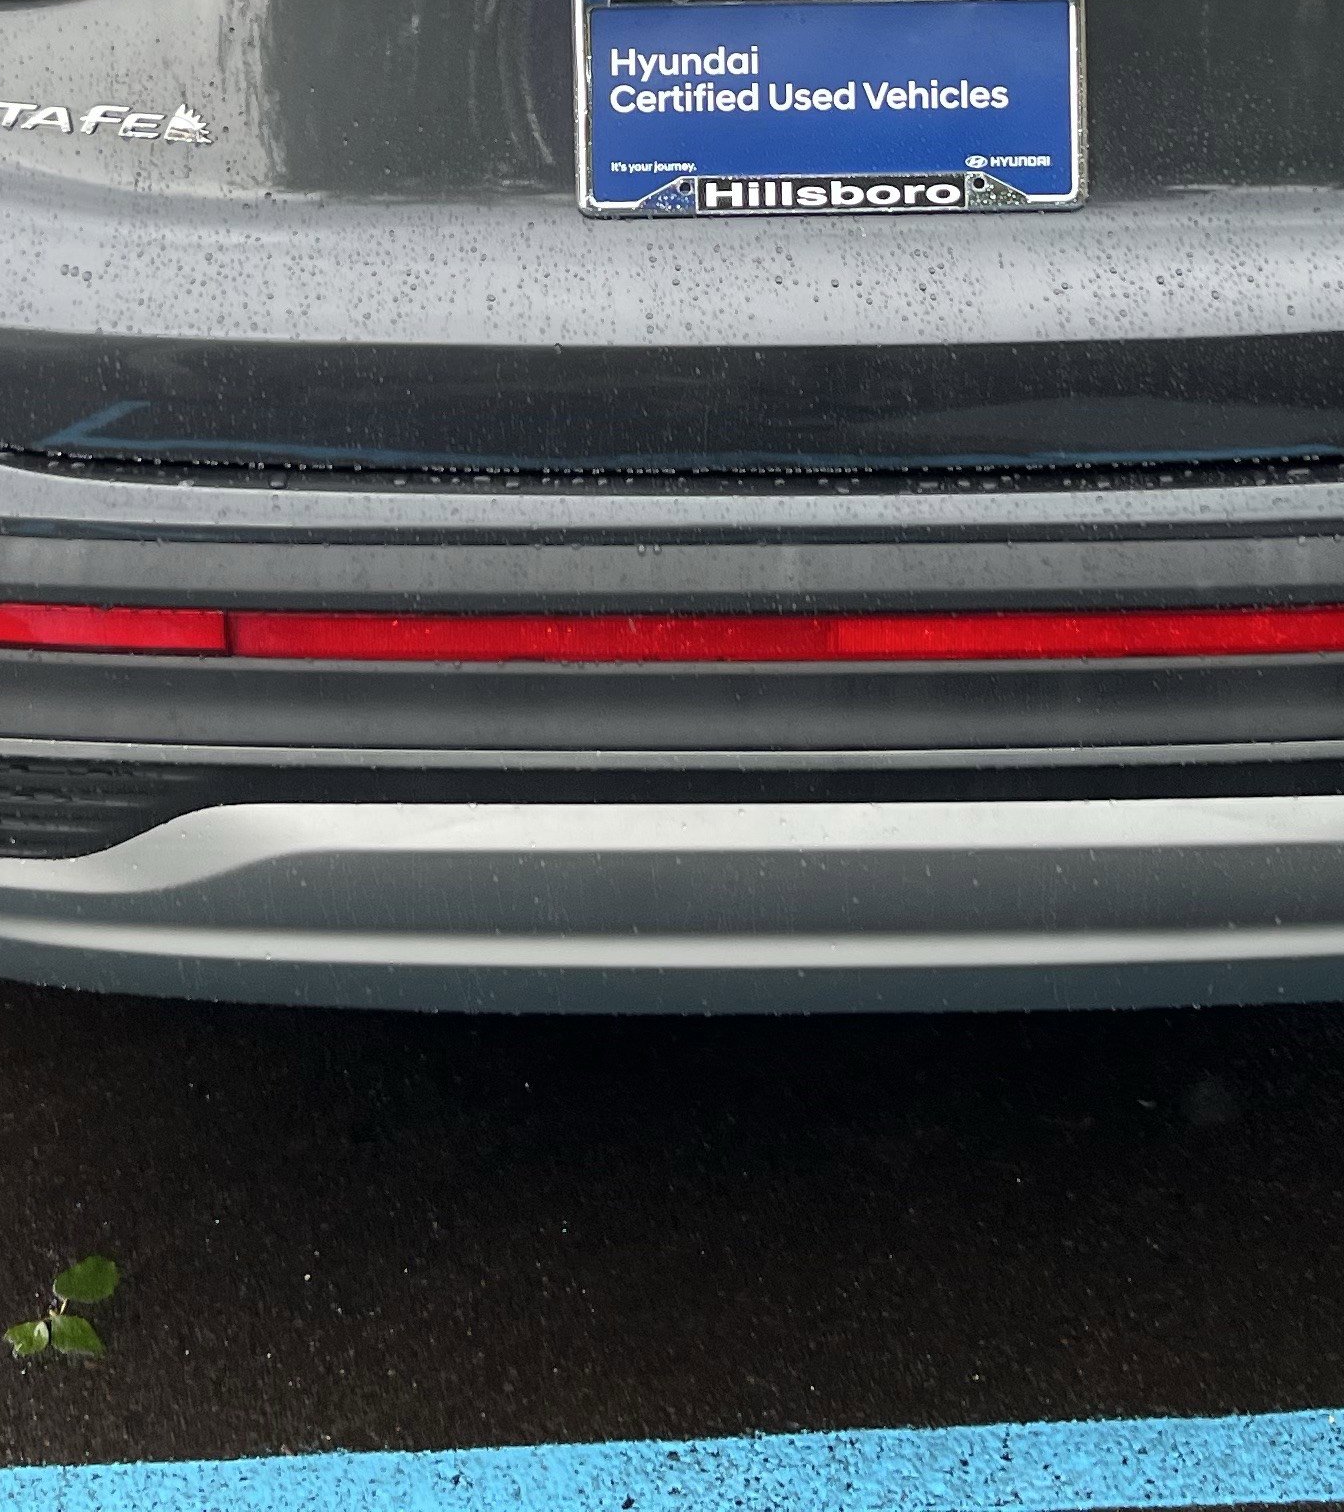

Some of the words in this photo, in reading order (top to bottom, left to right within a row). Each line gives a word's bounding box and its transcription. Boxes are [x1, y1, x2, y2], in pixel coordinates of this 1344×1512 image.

[610, 45, 759, 82] Hyundai
[610, 82, 759, 113] Certified
[768, 81, 856, 111] Used
[862, 79, 1010, 110] Vehicles
[80, 104, 167, 139] FE
[611, 161, 628, 172] It's
[628, 163, 653, 173] your
[990, 155, 1051, 167] HYUNDAI
[705, 178, 960, 207] Hillsboro
